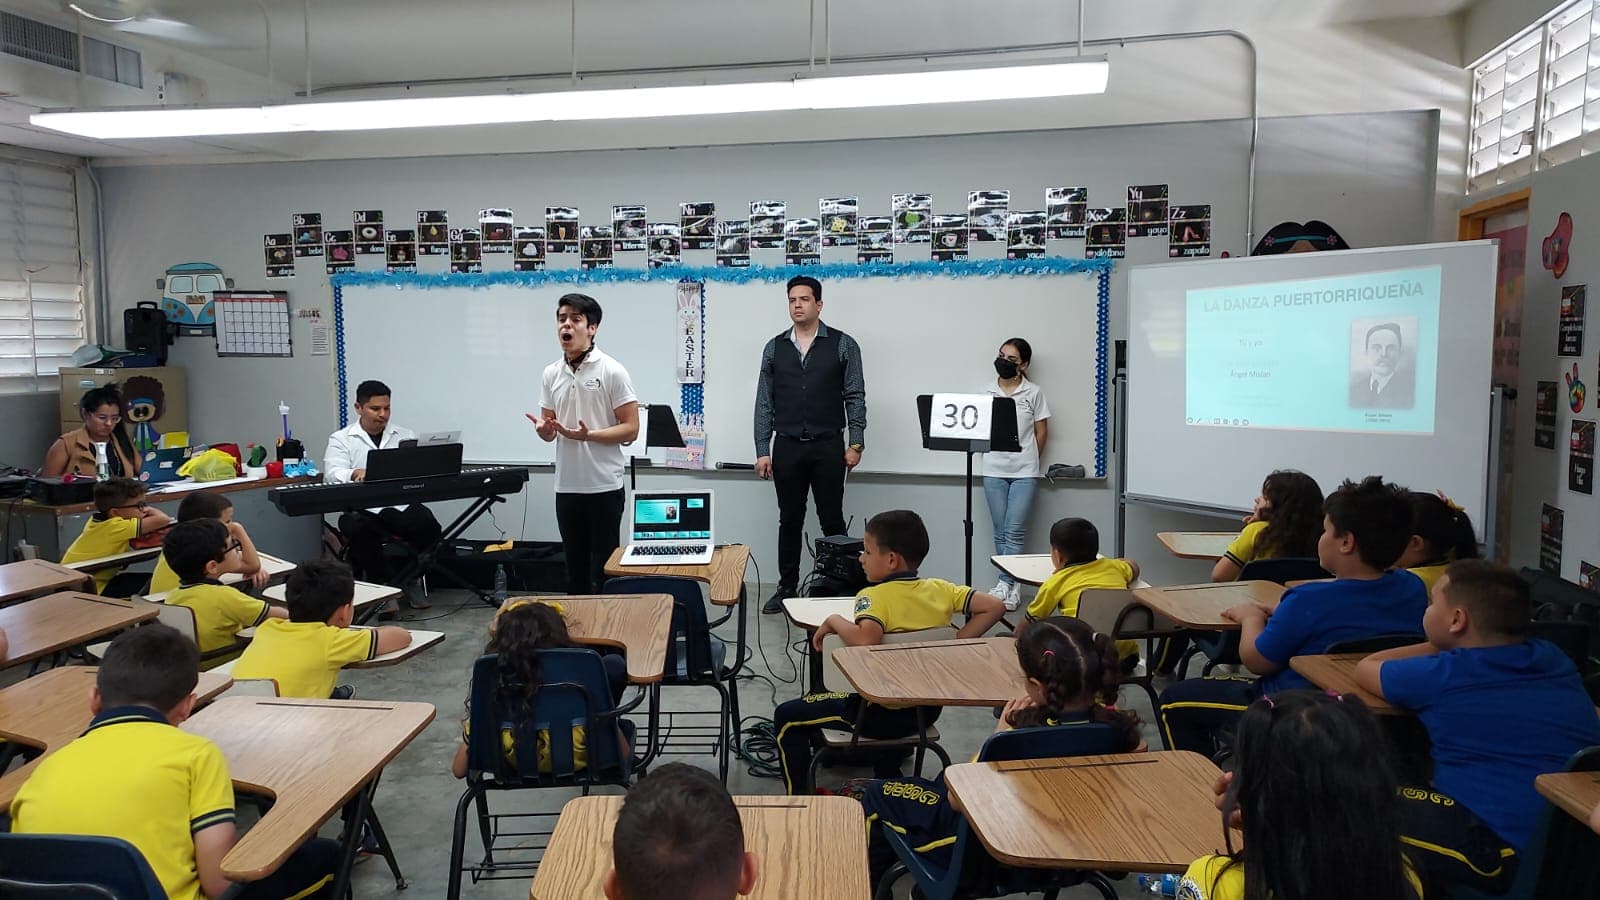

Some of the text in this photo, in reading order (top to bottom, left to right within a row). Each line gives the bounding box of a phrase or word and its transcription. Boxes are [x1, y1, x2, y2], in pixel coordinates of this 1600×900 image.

[354, 212, 367, 222] Dd
[1171, 207, 1186, 219] Zz
[293, 215, 306, 225] Bb
[265, 235, 276, 246] Aa
[325, 232, 337, 242] Cc
[1203, 281, 1425, 313] LA DANZA PUERTORRIQUEÑA
[684, 327, 695, 377] EASTER
[942, 403, 978, 430] 30
